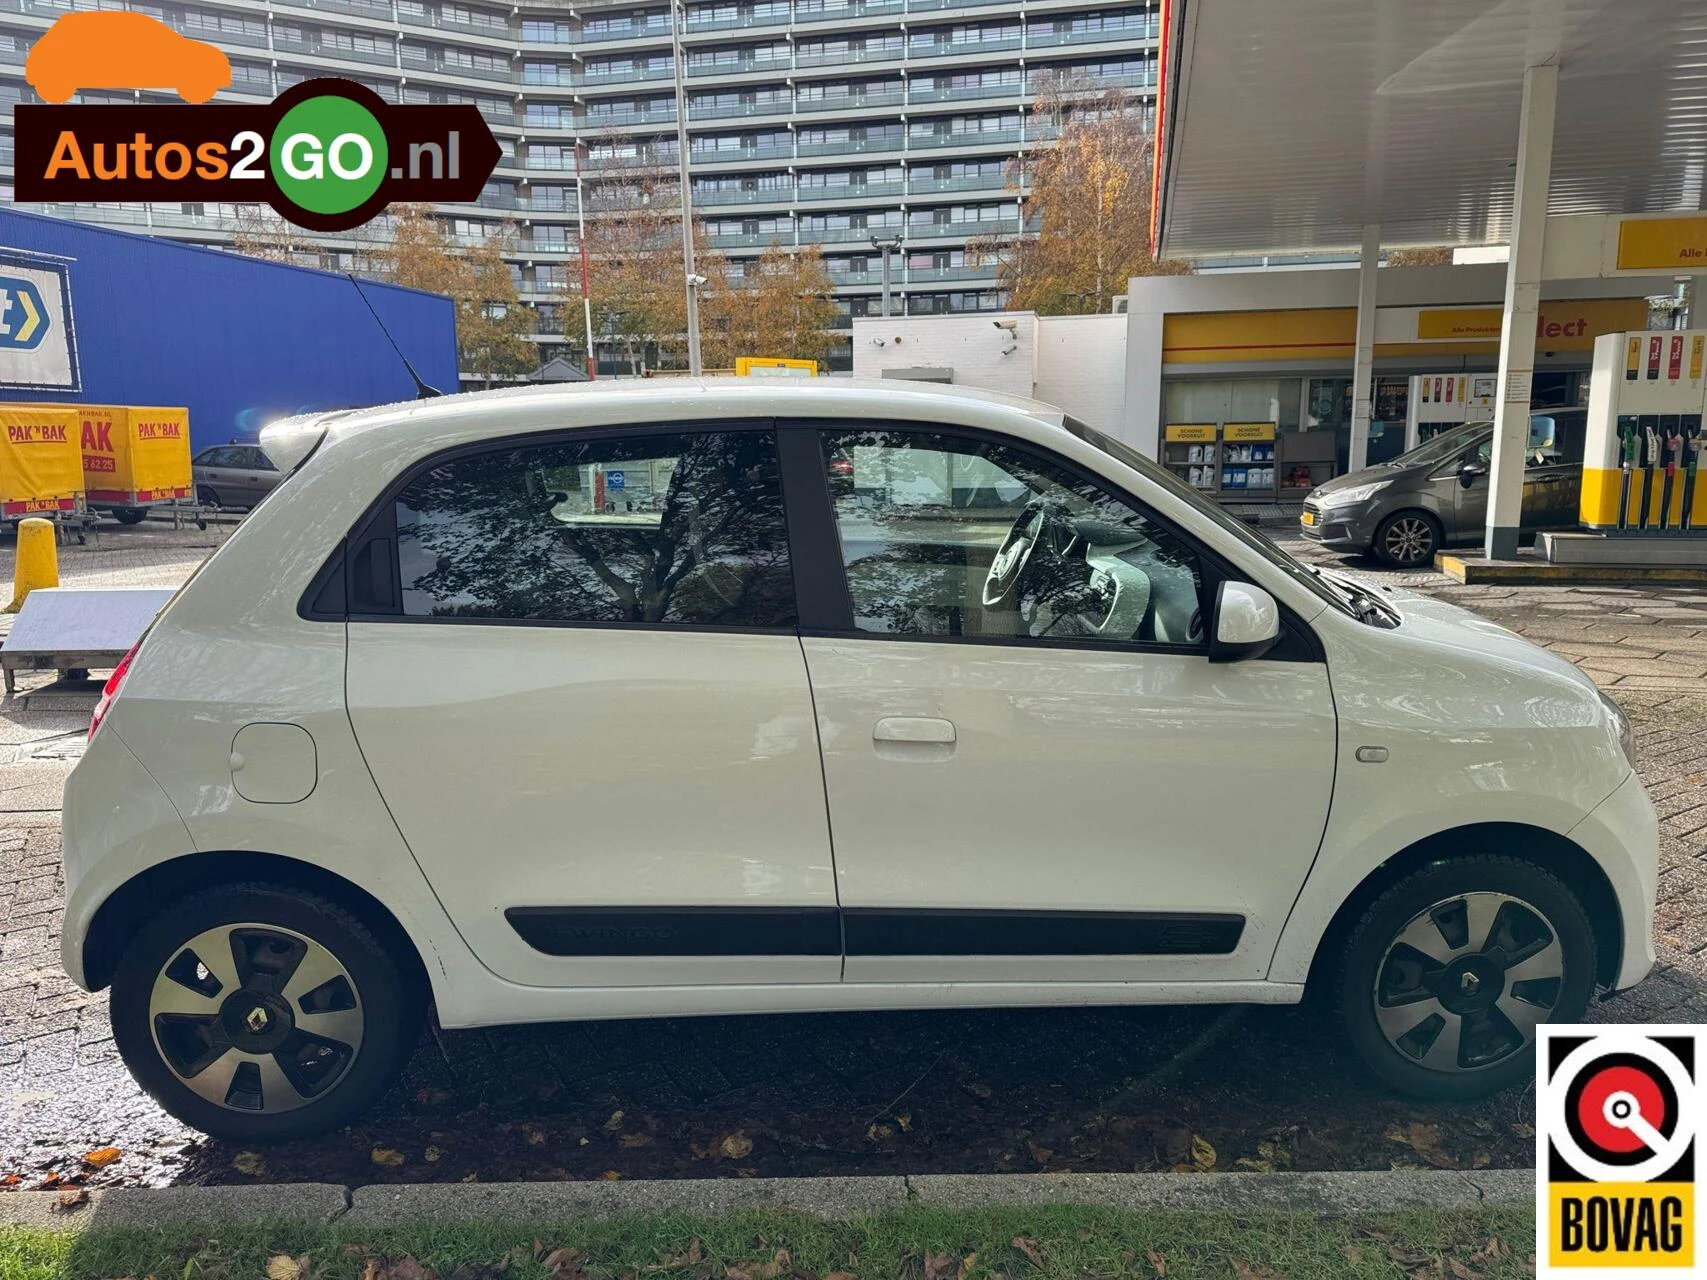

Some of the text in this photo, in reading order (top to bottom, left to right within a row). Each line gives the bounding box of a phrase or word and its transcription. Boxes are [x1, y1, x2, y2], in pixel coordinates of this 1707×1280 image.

[1679, 248, 1702, 258] Alle
[8, 425, 33, 441] PAK
[42, 425, 68, 441] BAK
[81, 420, 114, 453] AK
[138, 423, 156, 437] PAK
[162, 423, 180, 436] BAK
[103, 460, 114, 470] 25
